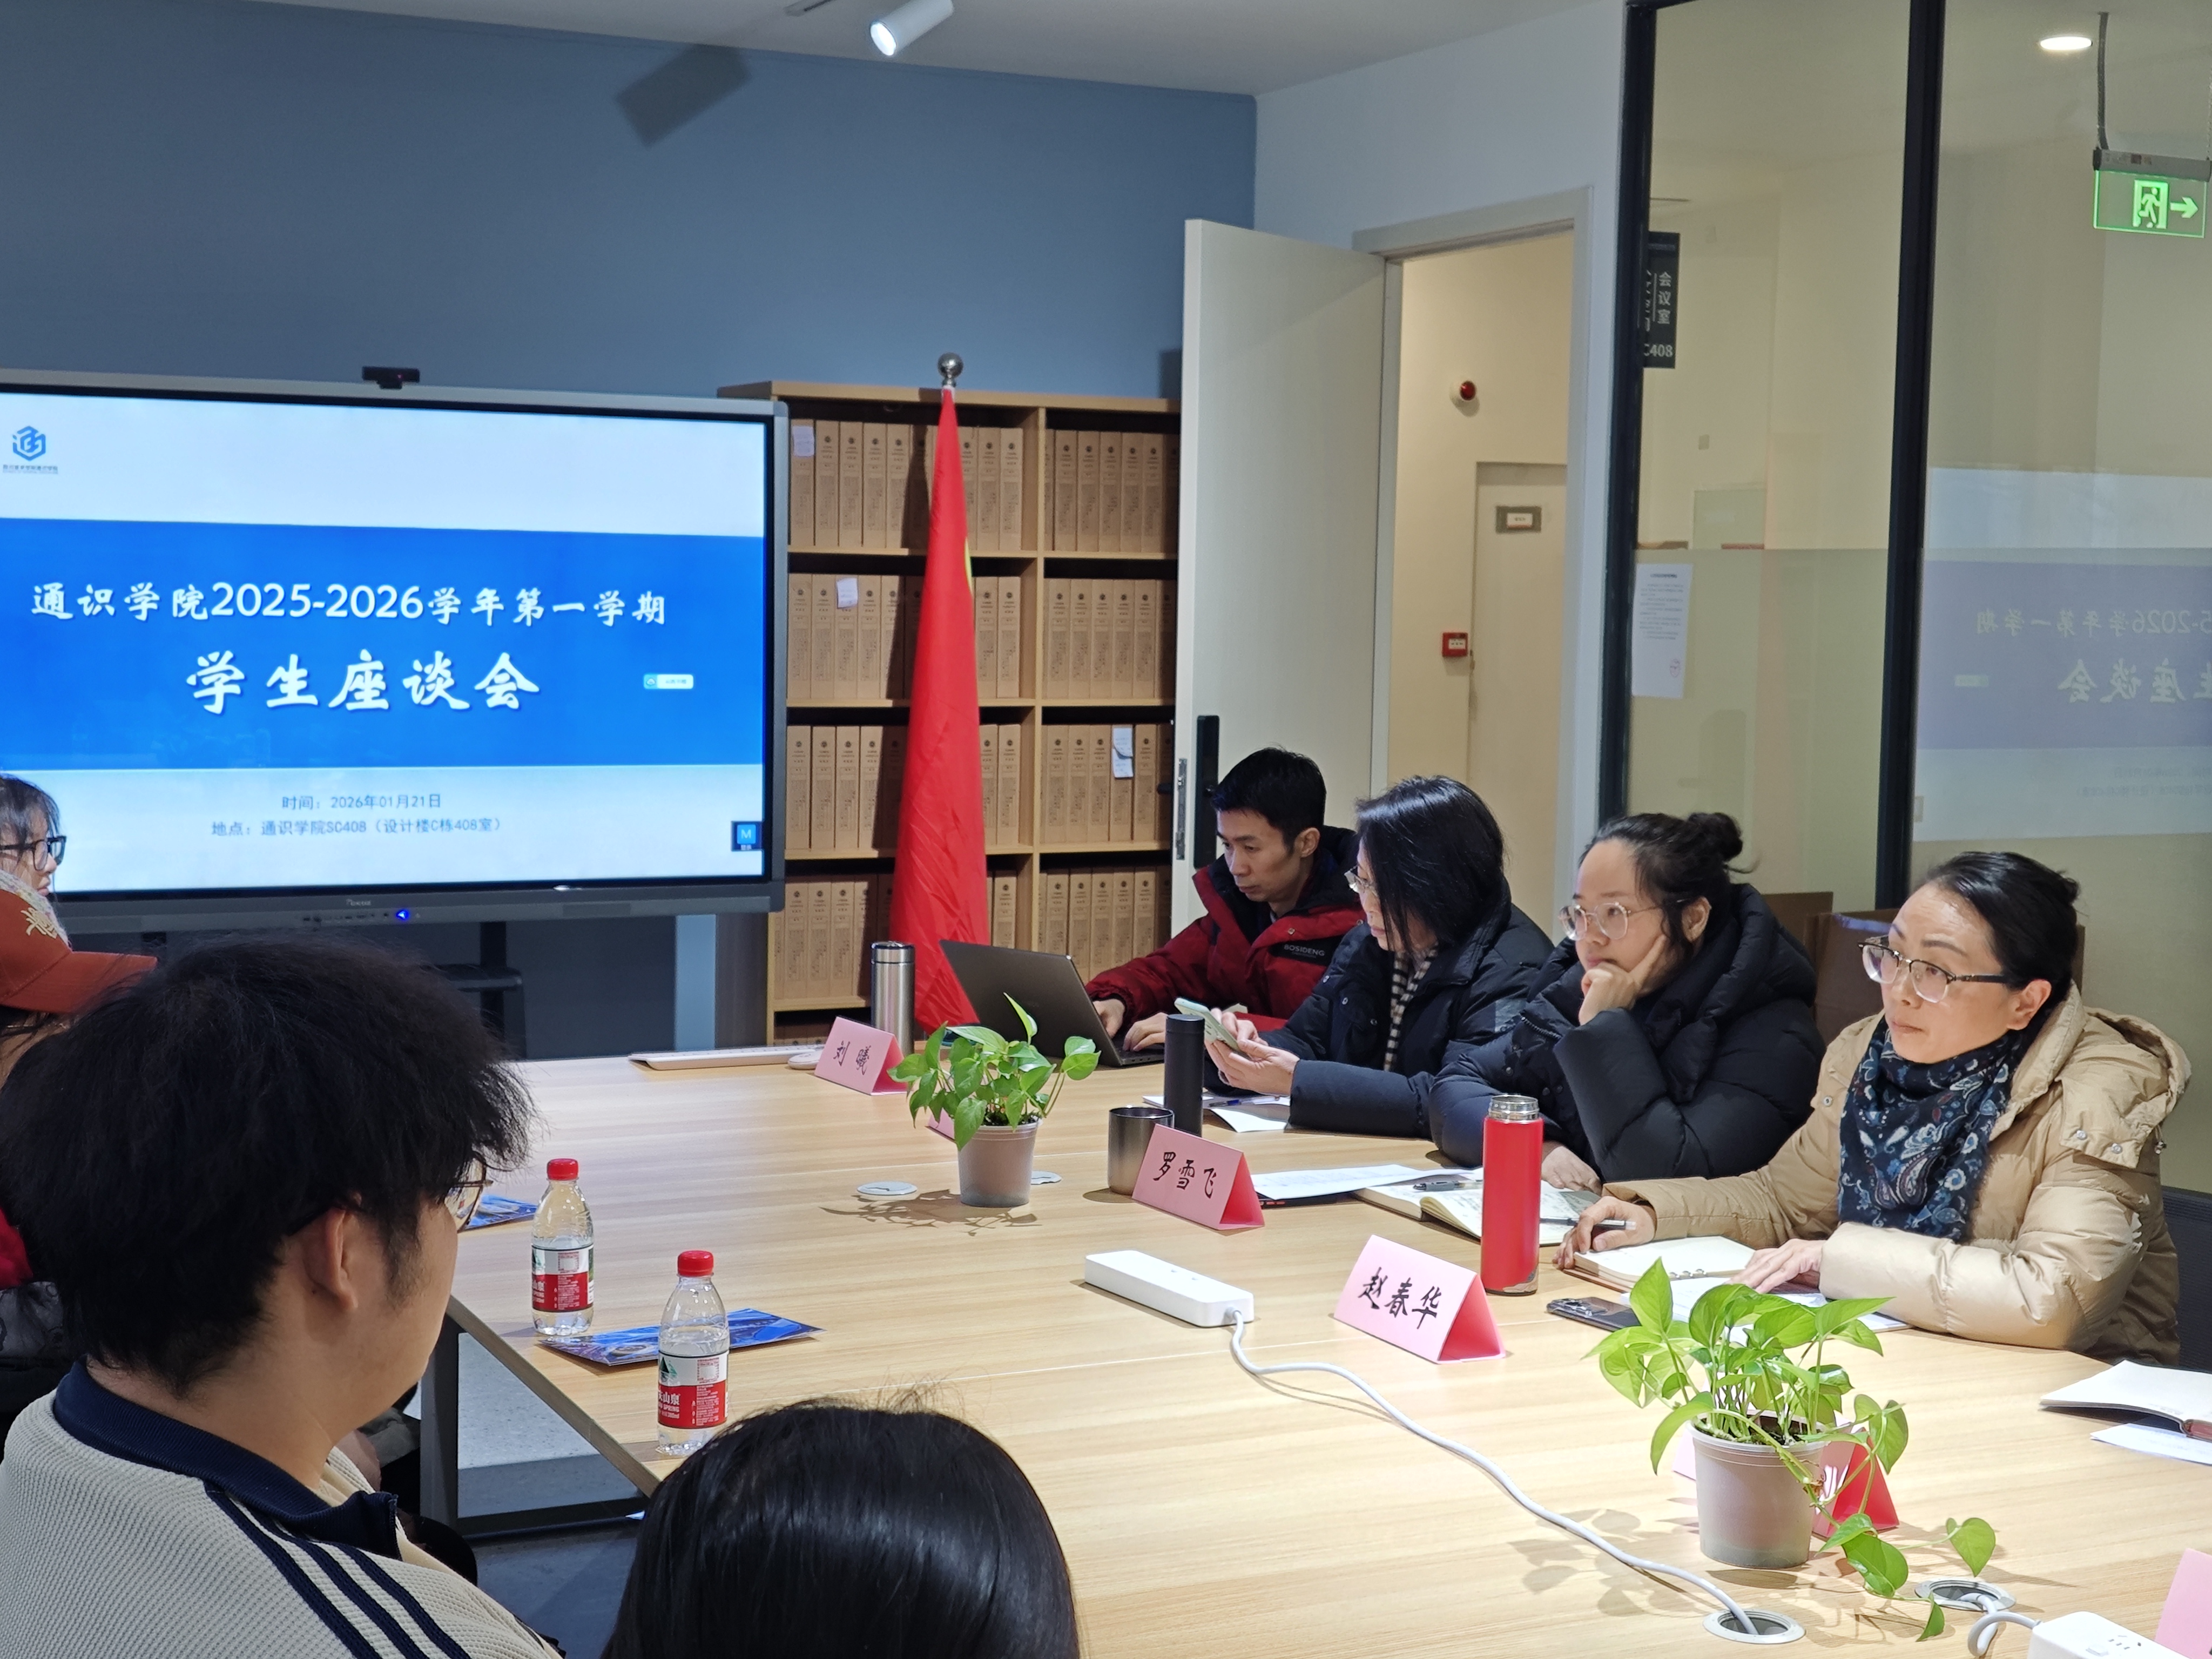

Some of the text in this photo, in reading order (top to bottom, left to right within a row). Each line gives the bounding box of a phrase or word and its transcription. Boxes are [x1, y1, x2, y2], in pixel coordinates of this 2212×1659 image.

[1657, 271, 1672, 325] 会议室
[31, 582, 665, 627] 通识学院2025-2026学年第一学期
[186, 649, 539, 714] 学生座谈会
[741, 829, 751, 839] M
[1284, 943, 1325, 956] BOSIDENG
[1152, 1151, 1217, 1199] 罗雪飞
[1357, 1266, 1442, 1330] 赵春华
